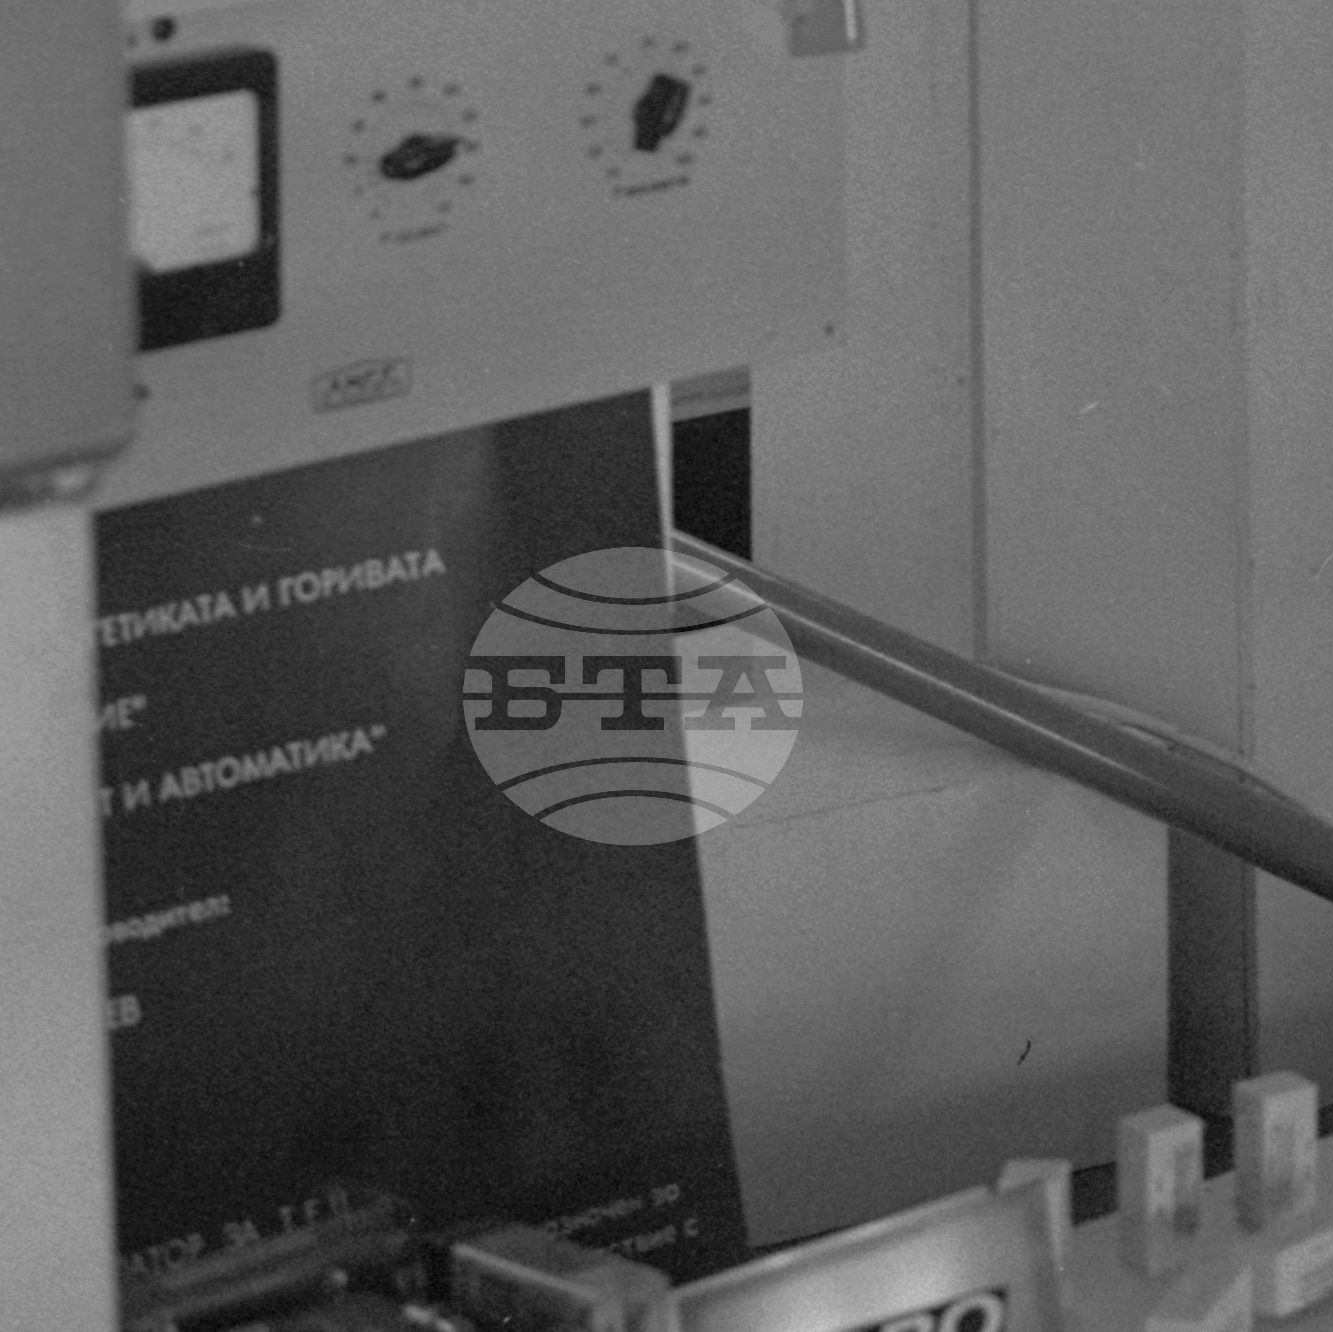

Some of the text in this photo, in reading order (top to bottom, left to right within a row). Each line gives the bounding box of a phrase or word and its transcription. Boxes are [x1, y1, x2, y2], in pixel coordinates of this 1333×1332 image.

[98, 548, 446, 648] ЕТИКАТА И ГОРИВАТА
[122, 778, 151, 811] И
